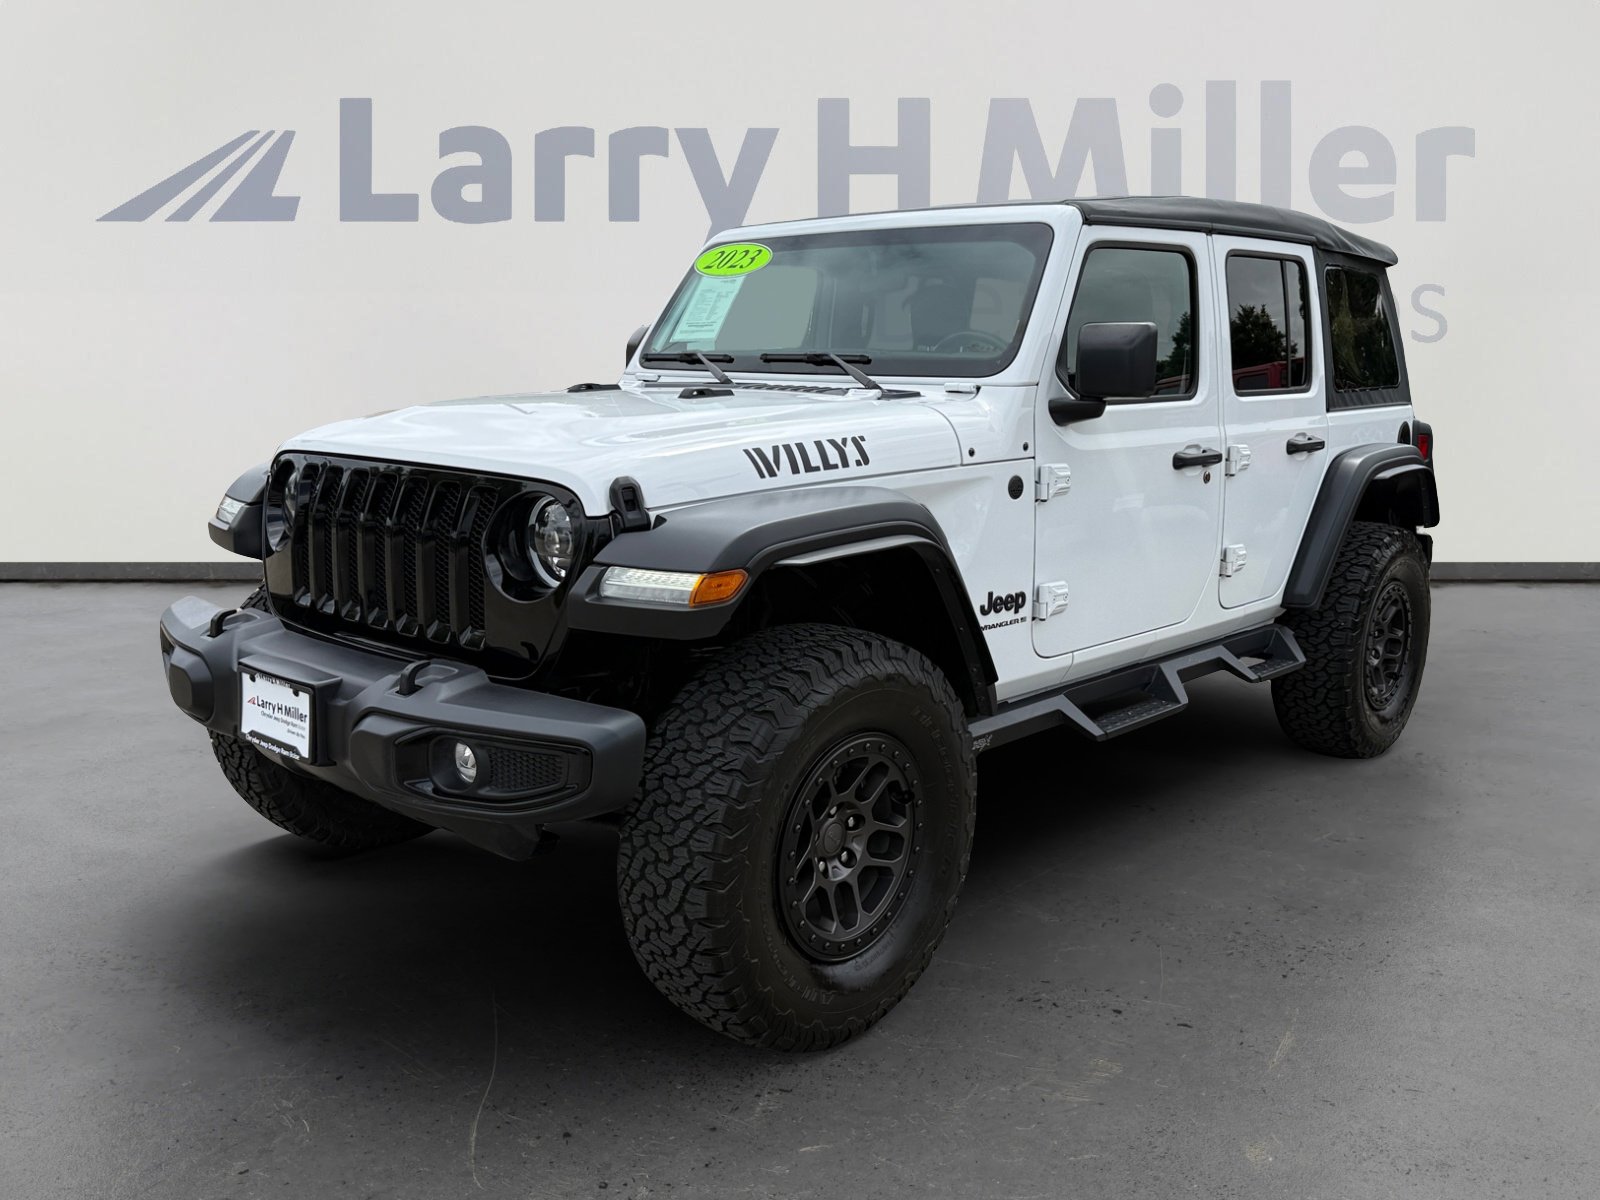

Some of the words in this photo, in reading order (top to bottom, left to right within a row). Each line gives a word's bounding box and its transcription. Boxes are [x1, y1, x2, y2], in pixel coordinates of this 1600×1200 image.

[340, 97, 780, 240] Larry
[817, 97, 931, 217] H
[977, 80, 1476, 222] Miller
[703, 249, 762, 270] 2023
[742, 435, 870, 479] WILLYS
[980, 591, 1026, 616] Jeep
[256, 695, 276, 714] Larry
[277, 702, 283, 715] H
[284, 704, 308, 723] Miller
